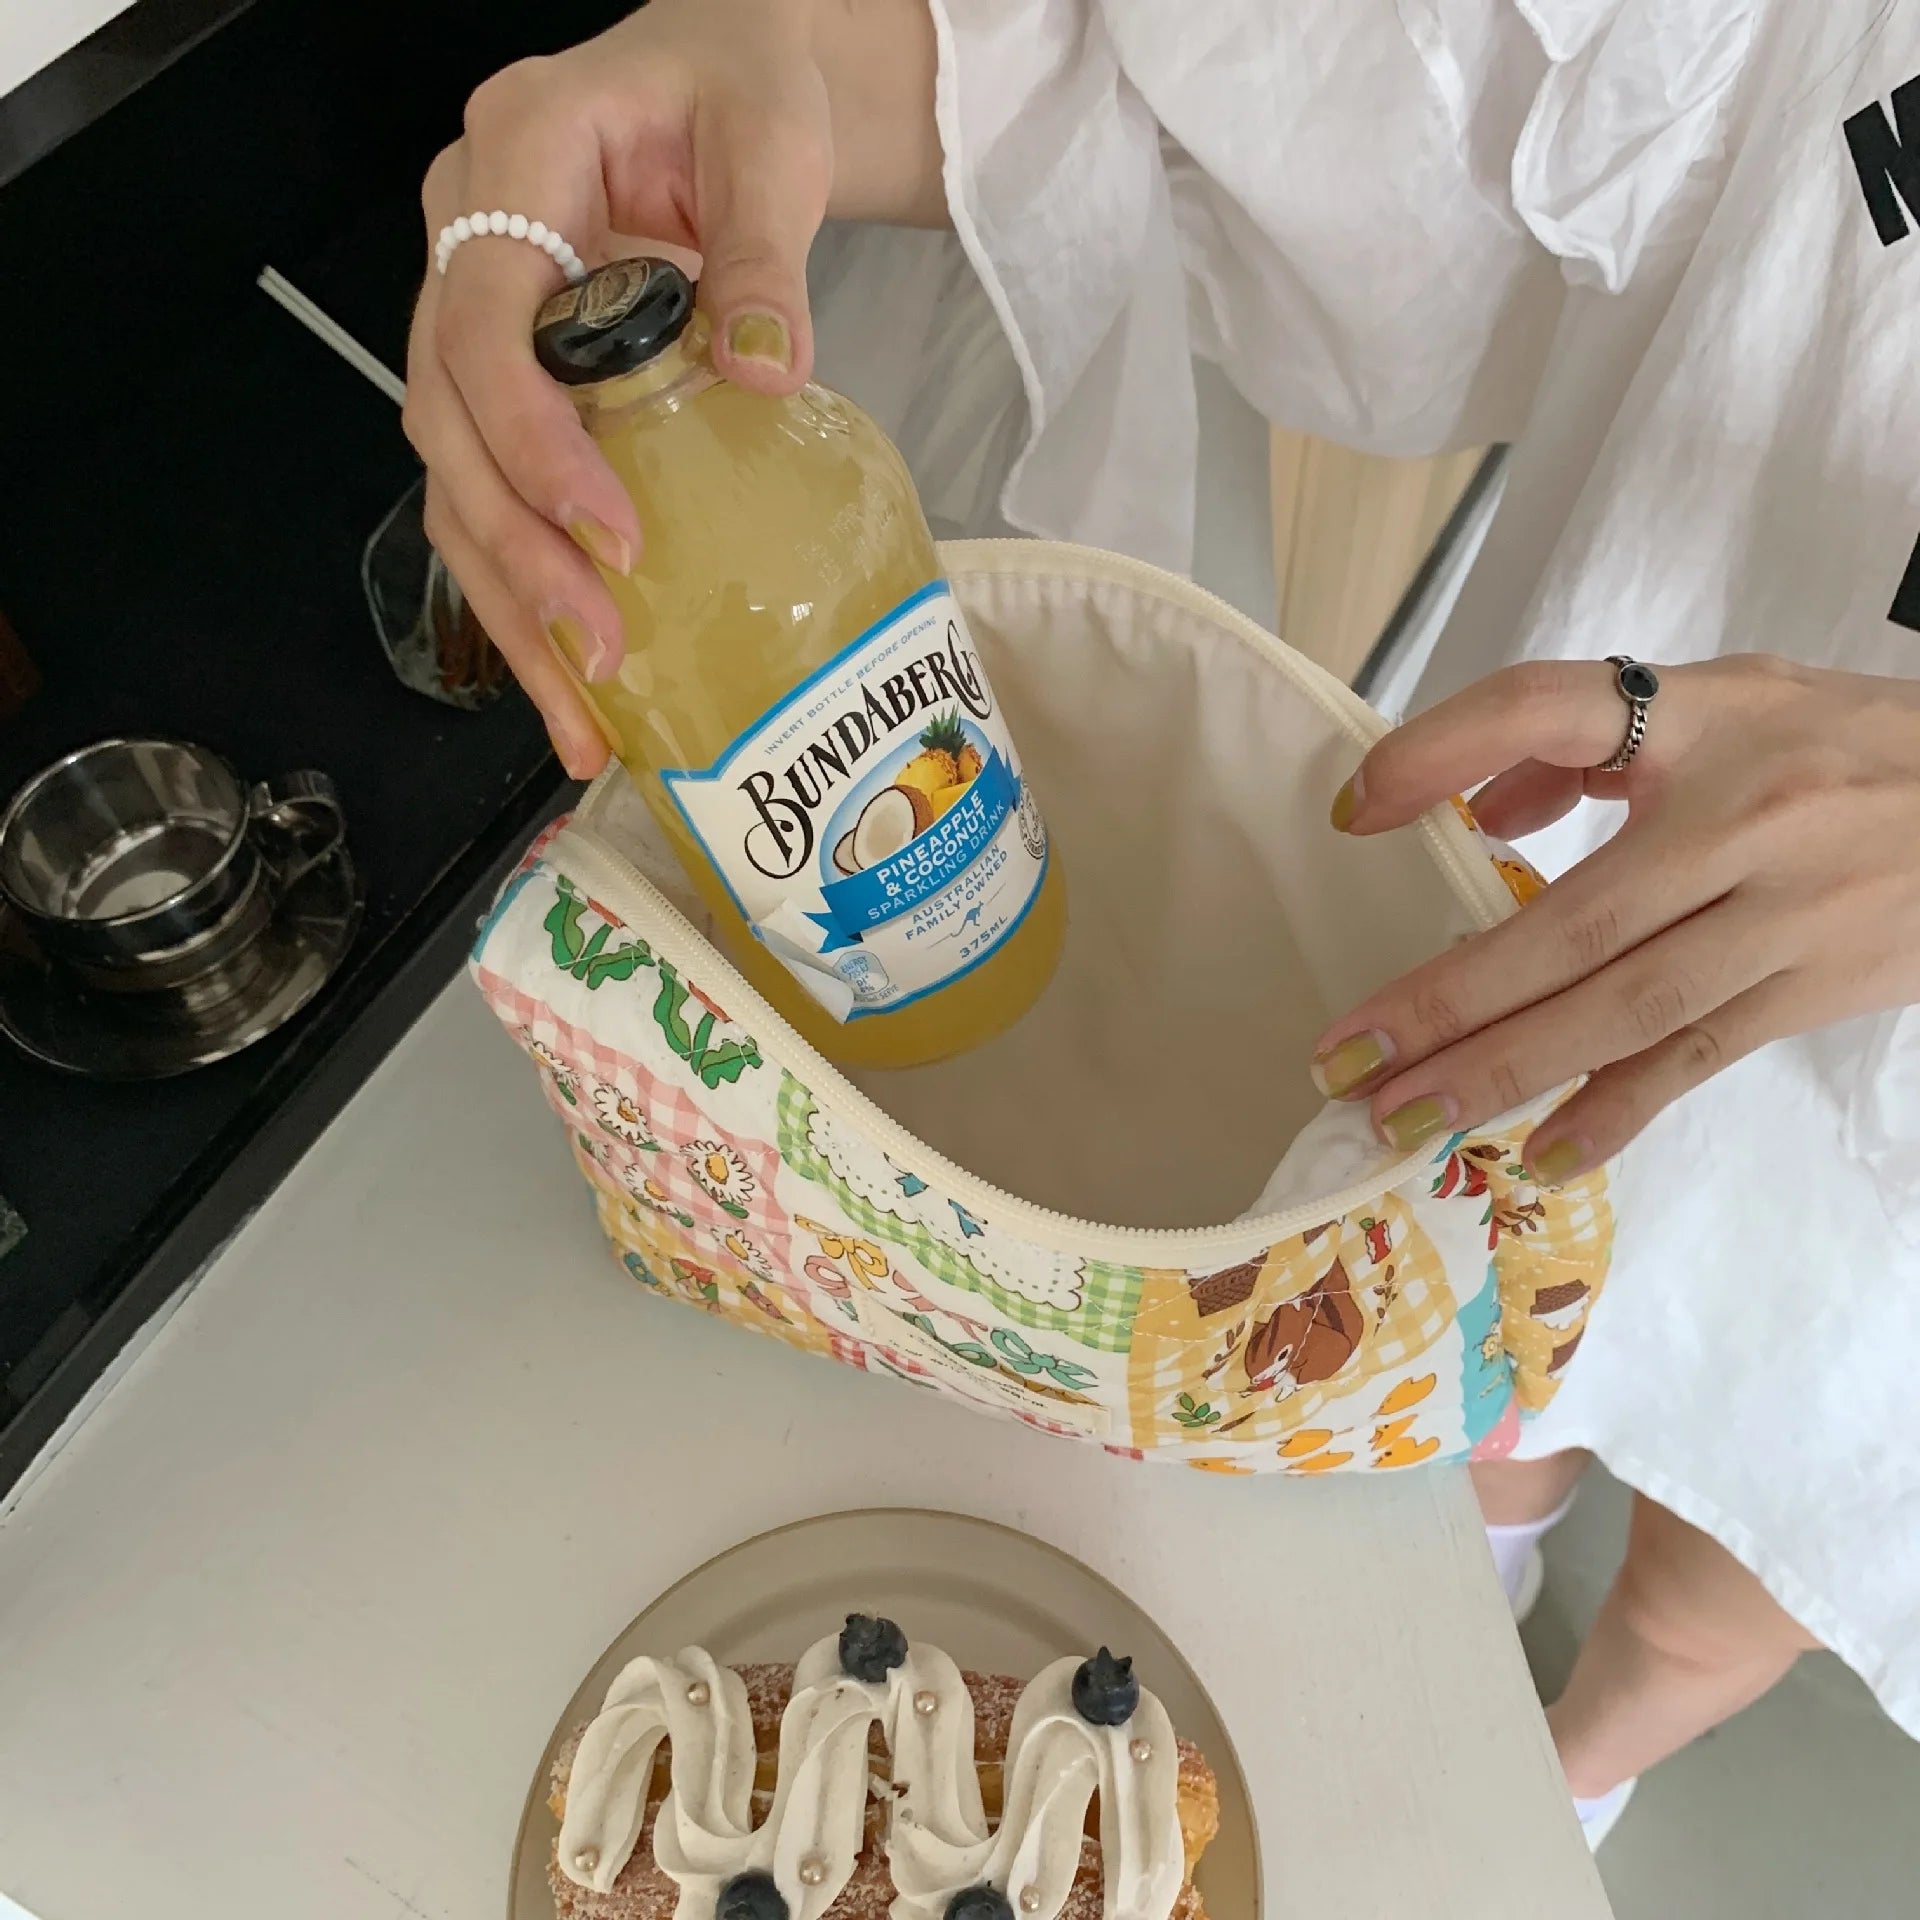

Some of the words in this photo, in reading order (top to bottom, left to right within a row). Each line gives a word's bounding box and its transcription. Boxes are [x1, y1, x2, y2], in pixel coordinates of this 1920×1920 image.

[764, 718, 805, 755] INVERT
[806, 678, 854, 718] BOTTLE
[856, 642, 899, 679] BEFORE
[900, 616, 937, 644] OPENING
[737, 619, 991, 879] BUNDABERG
[867, 850, 967, 920] SPARKLING
[969, 800, 1005, 850] DRINK
[876, 789, 983, 884] PINEAPPLE
[885, 882, 902, 897] &
[904, 804, 987, 885] COCONUT
[912, 844, 1000, 924] AUSTRALIAN
[905, 900, 961, 941] FAMILY
[965, 850, 1008, 901] OWNED
